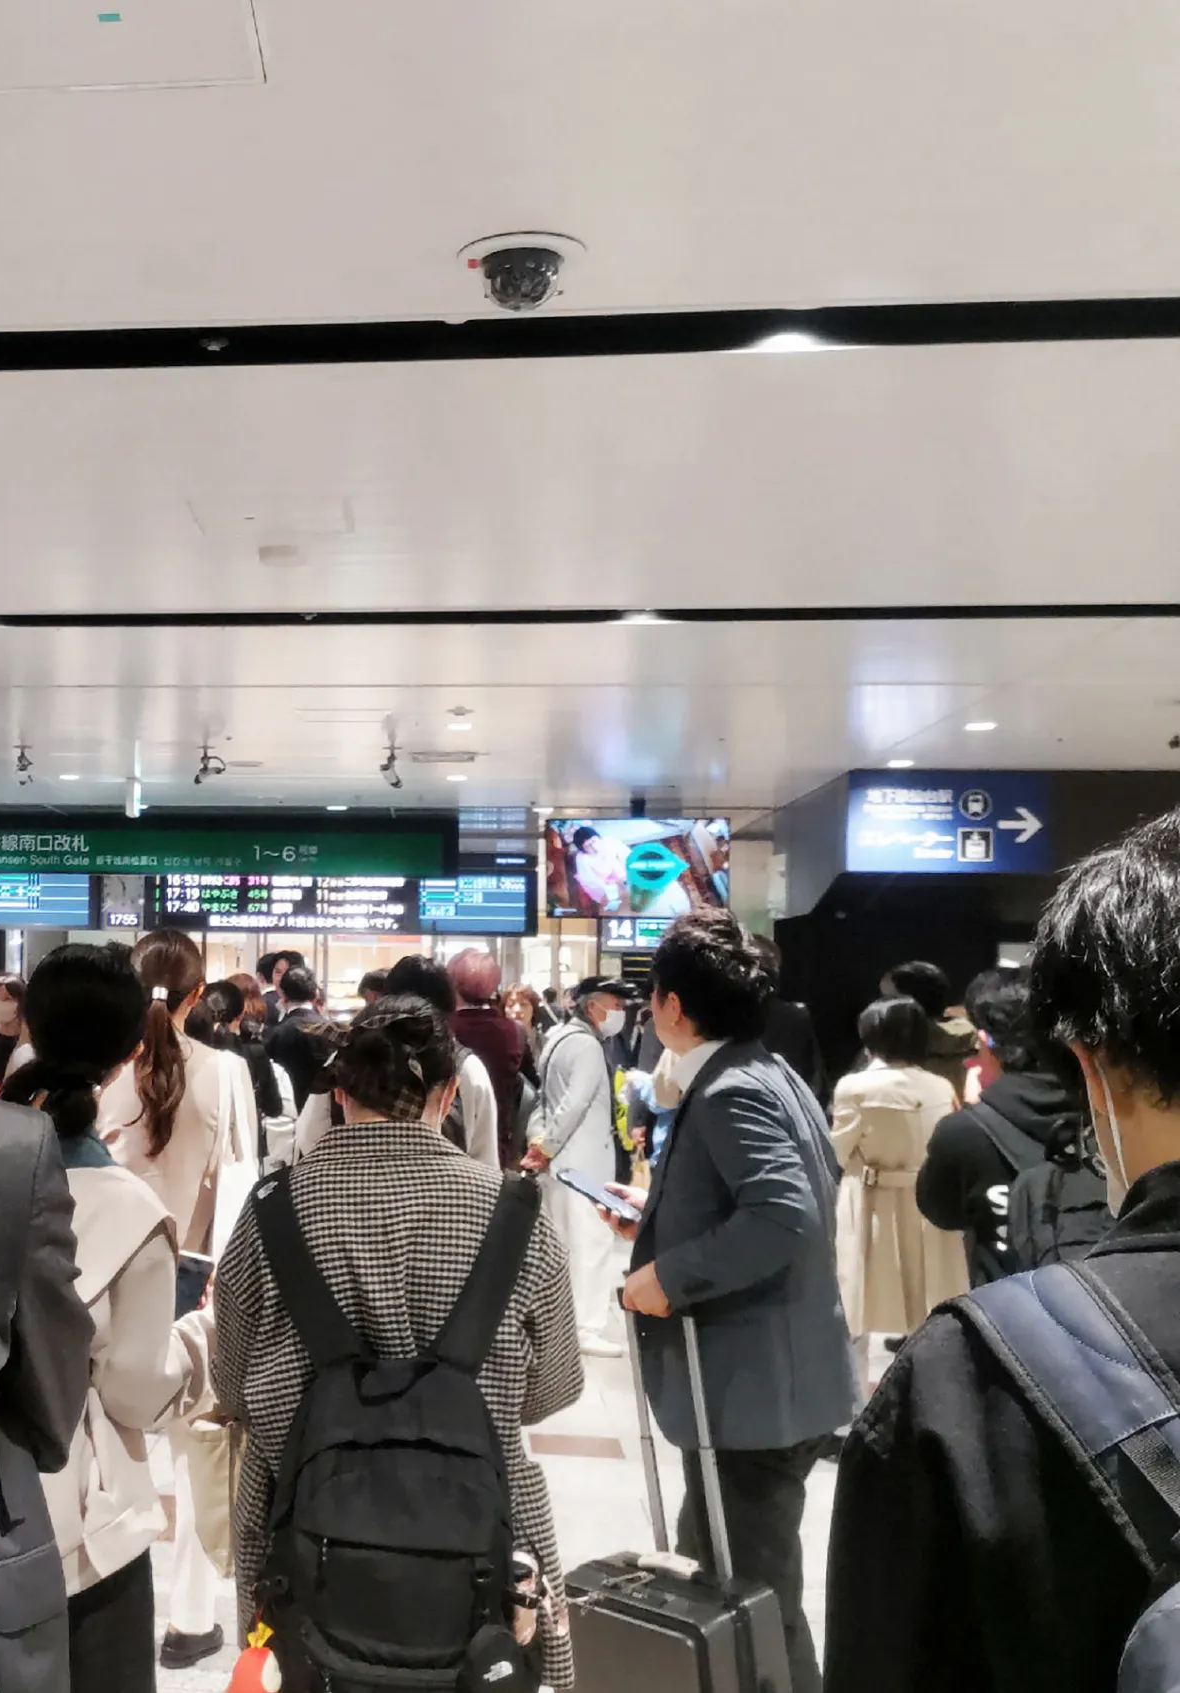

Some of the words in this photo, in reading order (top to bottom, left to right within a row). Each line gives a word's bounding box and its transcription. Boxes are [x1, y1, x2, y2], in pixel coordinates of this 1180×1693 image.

[30, 854, 60, 865] South
[63, 854, 89, 865] Gate
[166, 888, 200, 899] 17:19
[201, 889, 239, 899] はやぶさ
[166, 901, 200, 913] 17:40
[201, 903, 238, 913] やまびこ
[608, 919, 632, 938] 14
